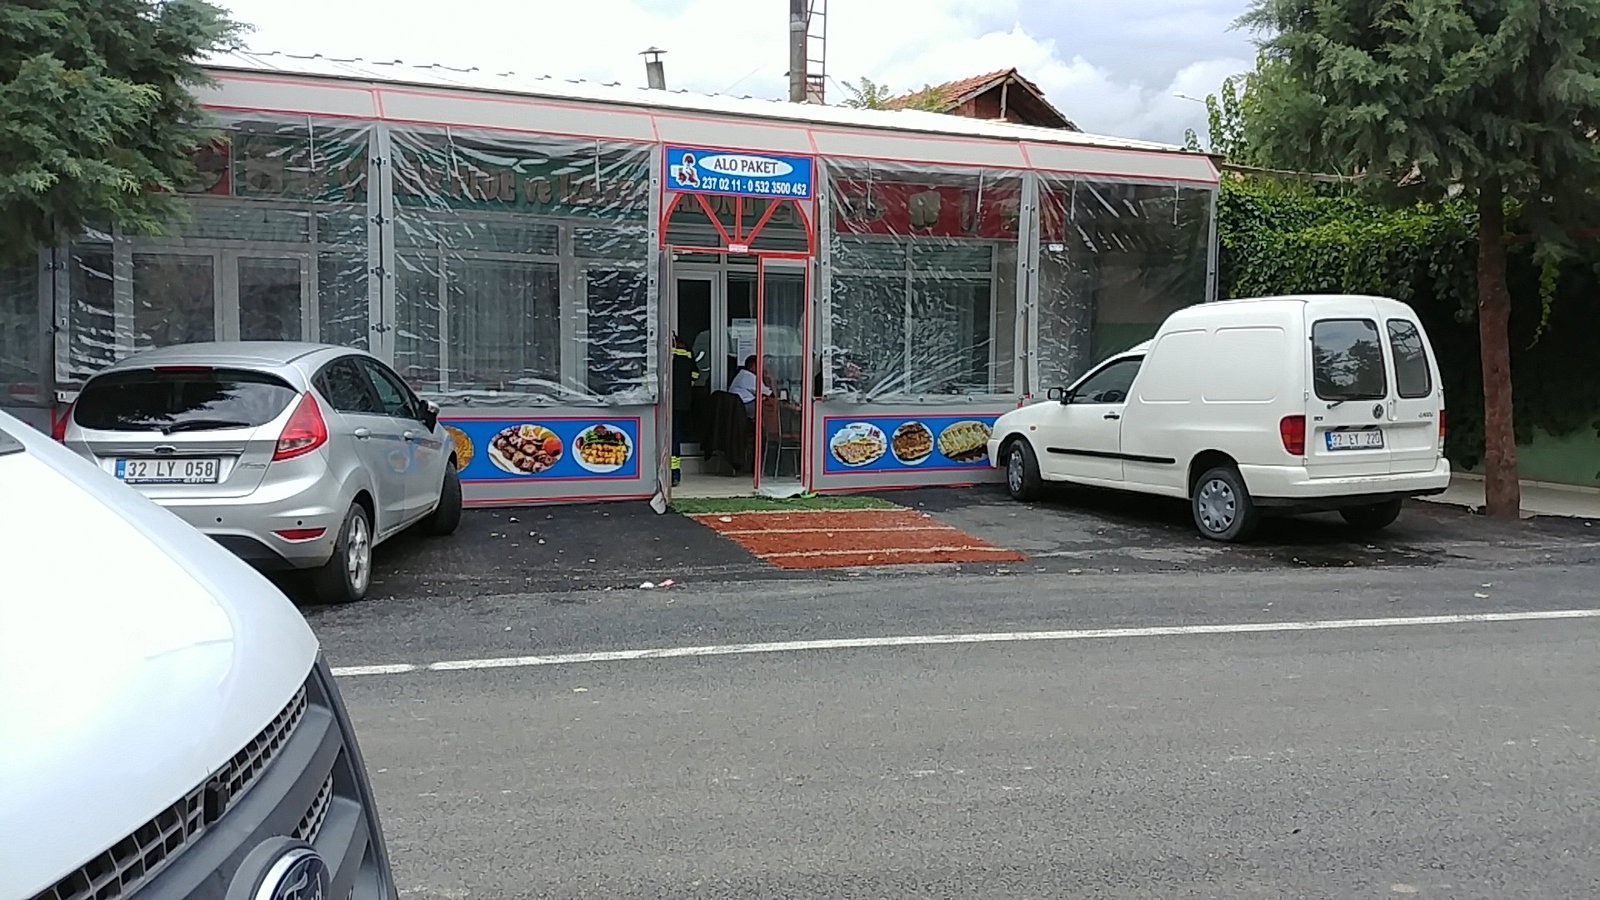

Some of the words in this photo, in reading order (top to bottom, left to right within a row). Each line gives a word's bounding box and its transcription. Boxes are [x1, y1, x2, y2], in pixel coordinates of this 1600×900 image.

[714, 158, 738, 171] ALO
[741, 159, 778, 174] PAKET
[702, 176, 717, 190] 237
[718, 177, 730, 191] 02
[731, 178, 741, 192] 11
[748, 180, 753, 193] 0
[755, 180, 770, 194] 532
[771, 181, 790, 195] 3500
[792, 182, 807, 196] 452
[128, 461, 148, 477] 32
[156, 461, 176, 477] LY
[185, 461, 214, 477] 058
